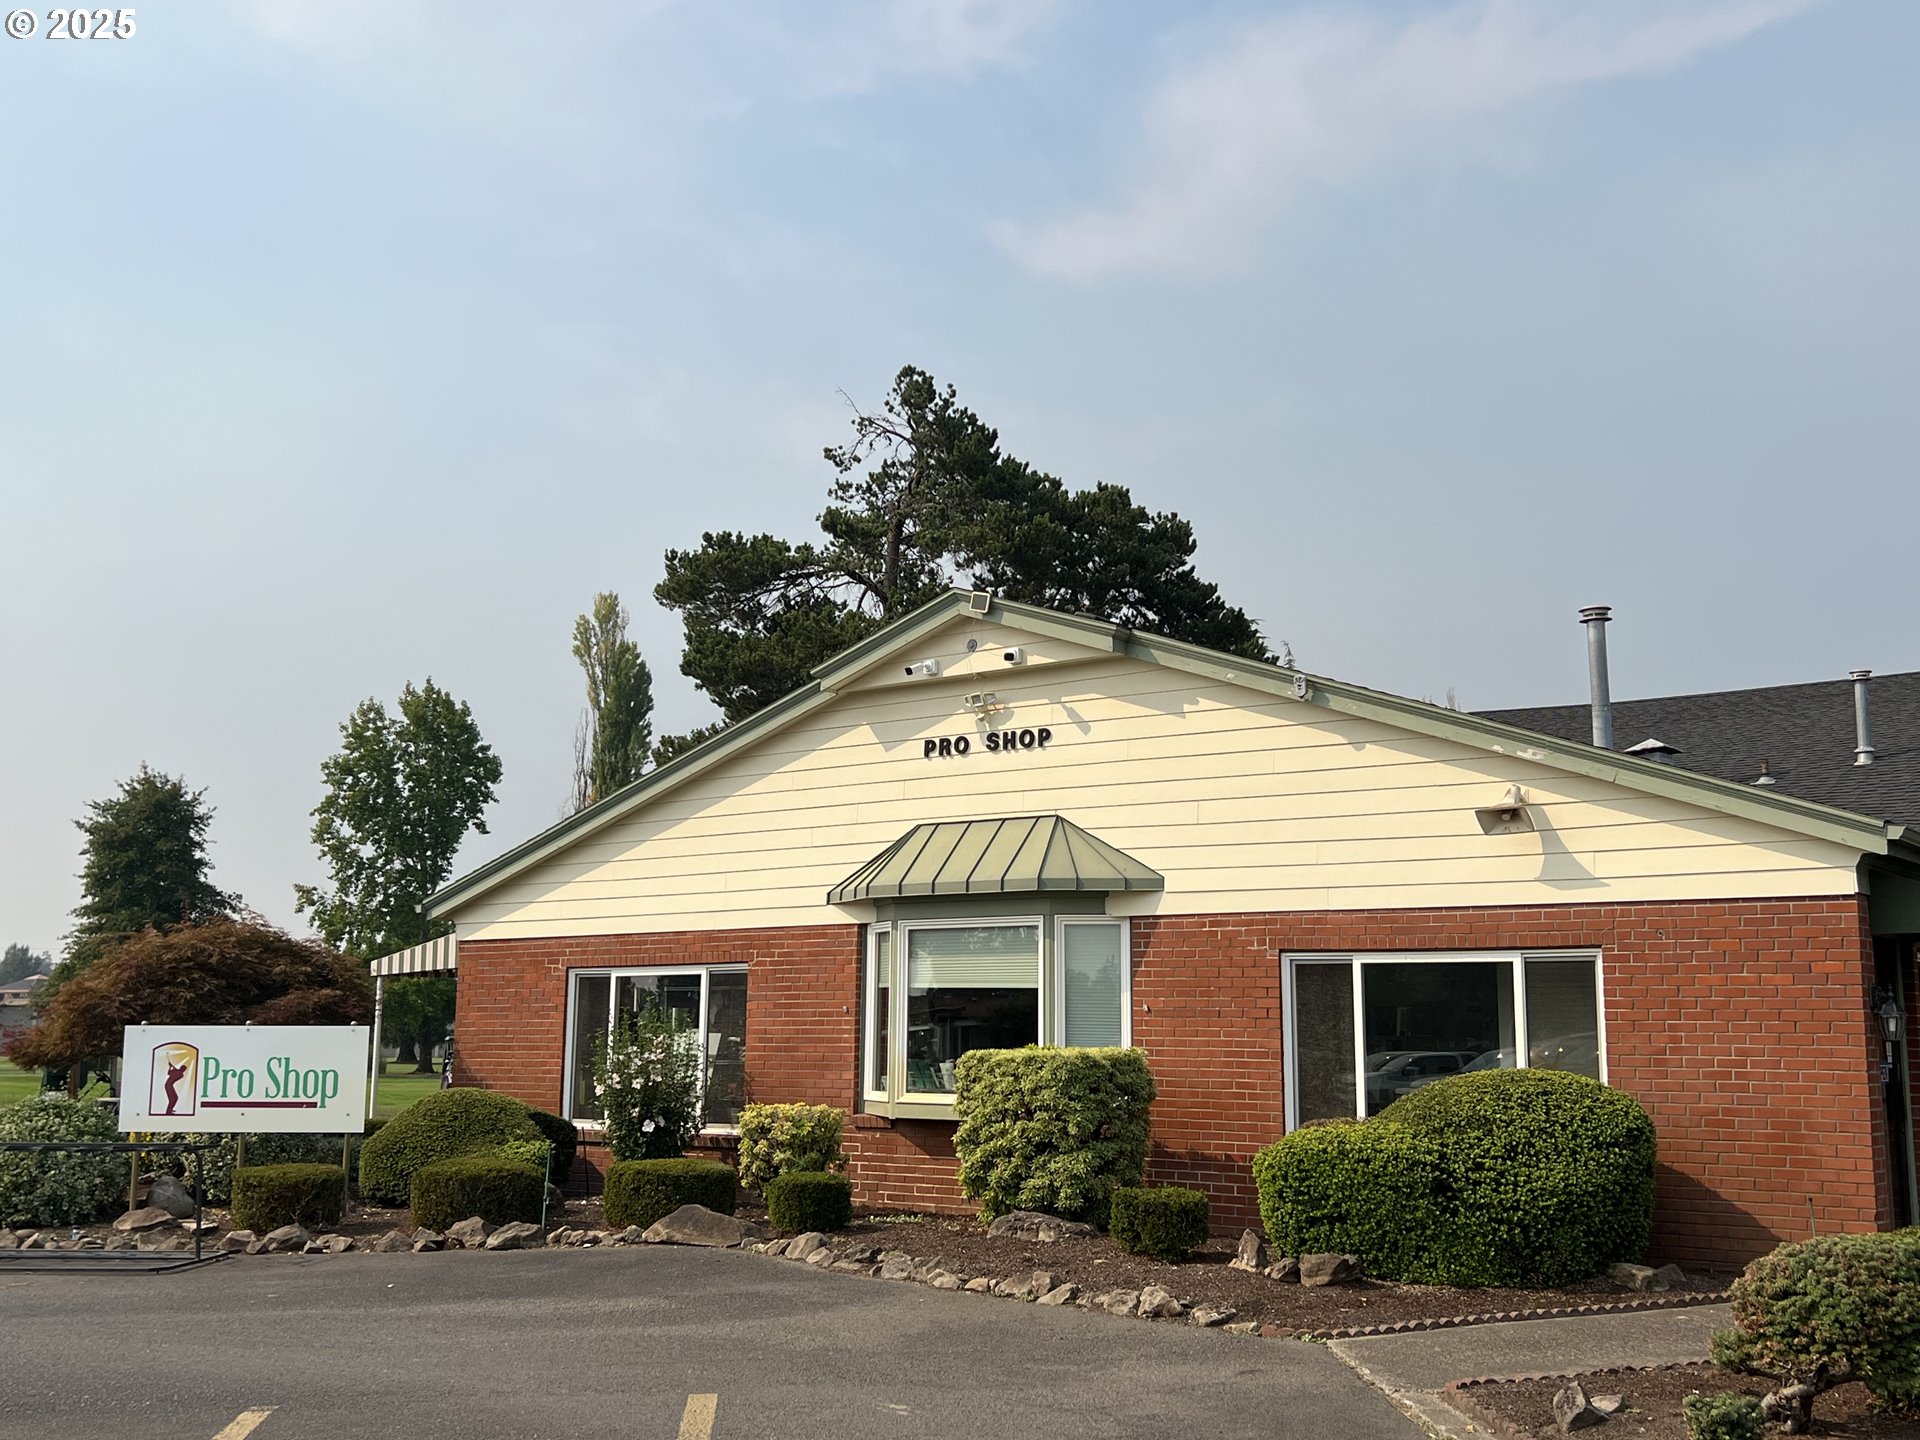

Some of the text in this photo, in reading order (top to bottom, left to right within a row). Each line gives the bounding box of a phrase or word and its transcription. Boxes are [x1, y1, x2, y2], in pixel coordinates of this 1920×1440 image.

[923, 727, 1052, 758] PRO SHOP
[201, 1056, 340, 1109] Pro Shop
